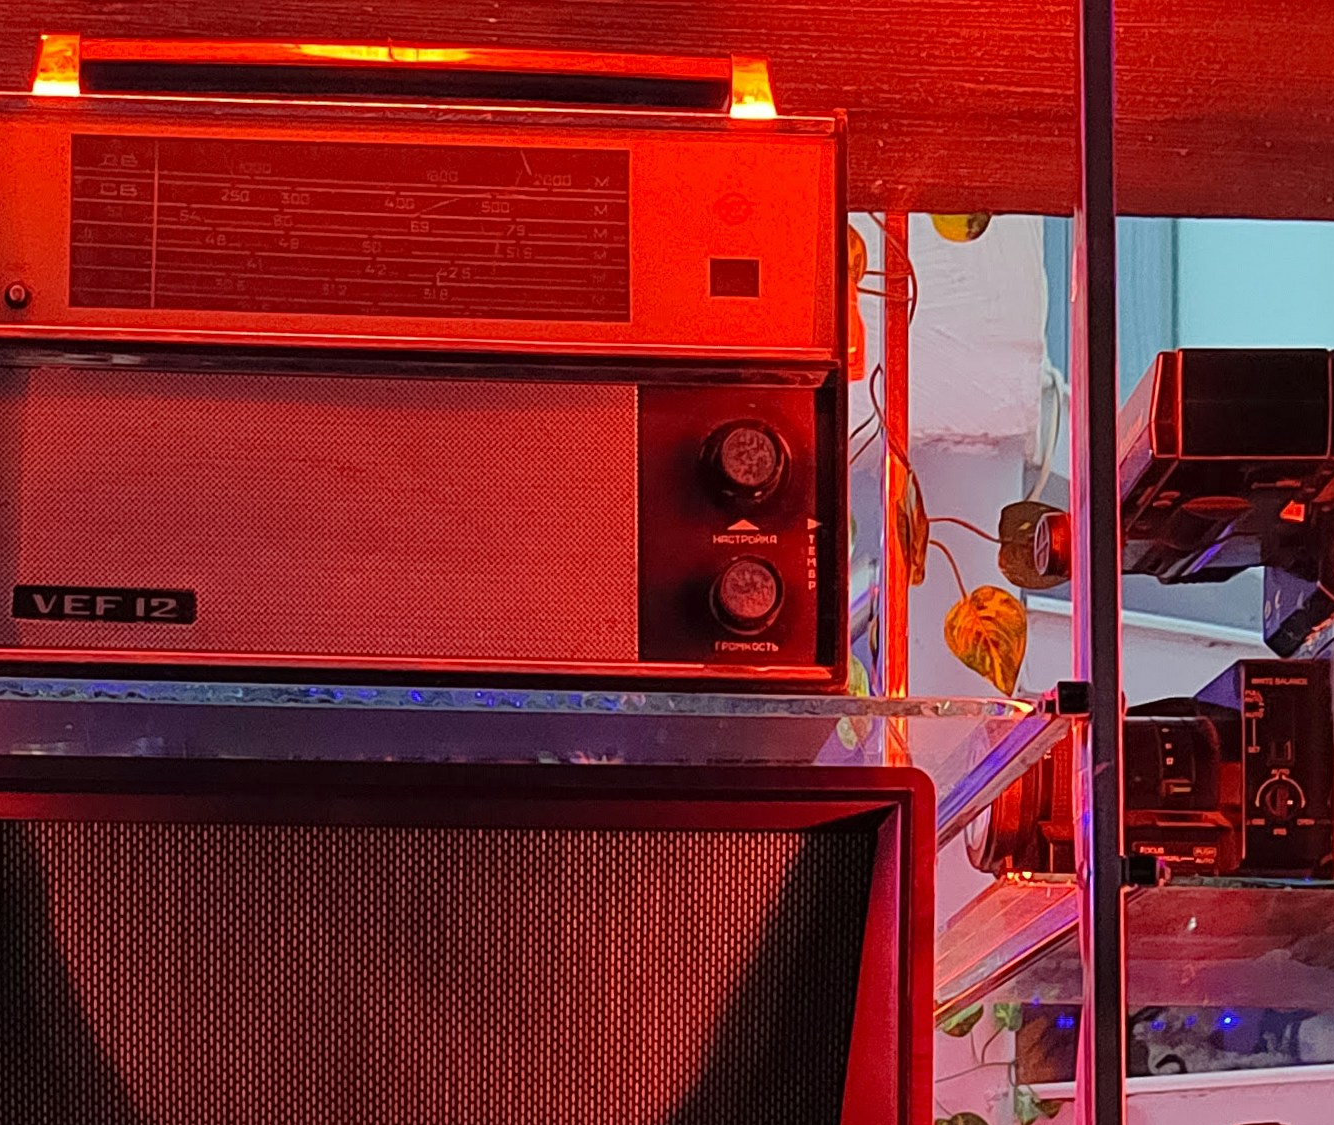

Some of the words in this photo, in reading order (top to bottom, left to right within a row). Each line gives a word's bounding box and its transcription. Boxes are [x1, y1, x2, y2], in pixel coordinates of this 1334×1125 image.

[481, 201, 510, 214] 500
[712, 534, 778, 545] НАСТРОЙКА
[32, 593, 123, 616] VEF
[135, 597, 178, 618] 12
[714, 641, 779, 652] ГРОМКОСТЬ
